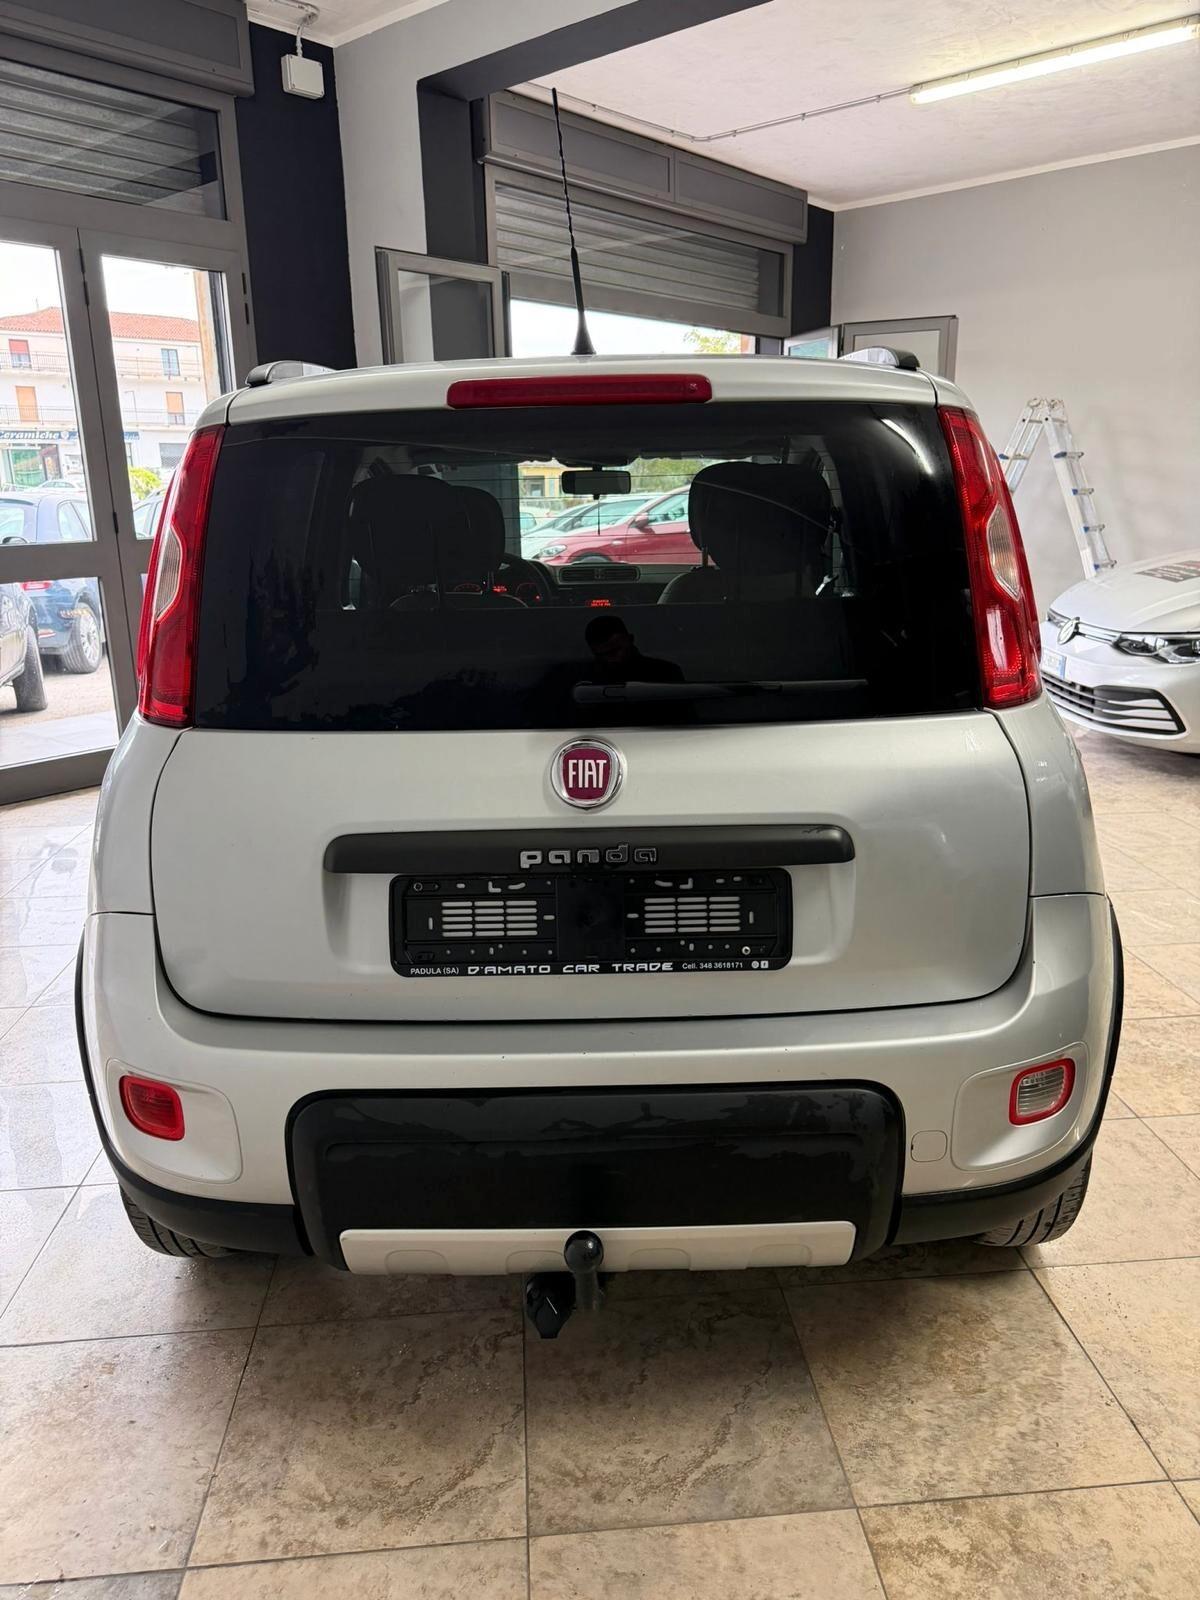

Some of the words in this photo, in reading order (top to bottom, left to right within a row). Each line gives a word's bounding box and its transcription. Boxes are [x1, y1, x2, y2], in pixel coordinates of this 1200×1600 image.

[568, 759, 607, 788] FIAT
[520, 844, 657, 869] panda
[410, 967, 441, 975] PADULA
[443, 966, 459, 975] (SA)
[467, 964, 551, 975] D'AMATO
[562, 964, 600, 973] CAR
[612, 962, 674, 972] TRADE
[682, 962, 698, 970] Cell.
[700, 961, 713, 969] 348
